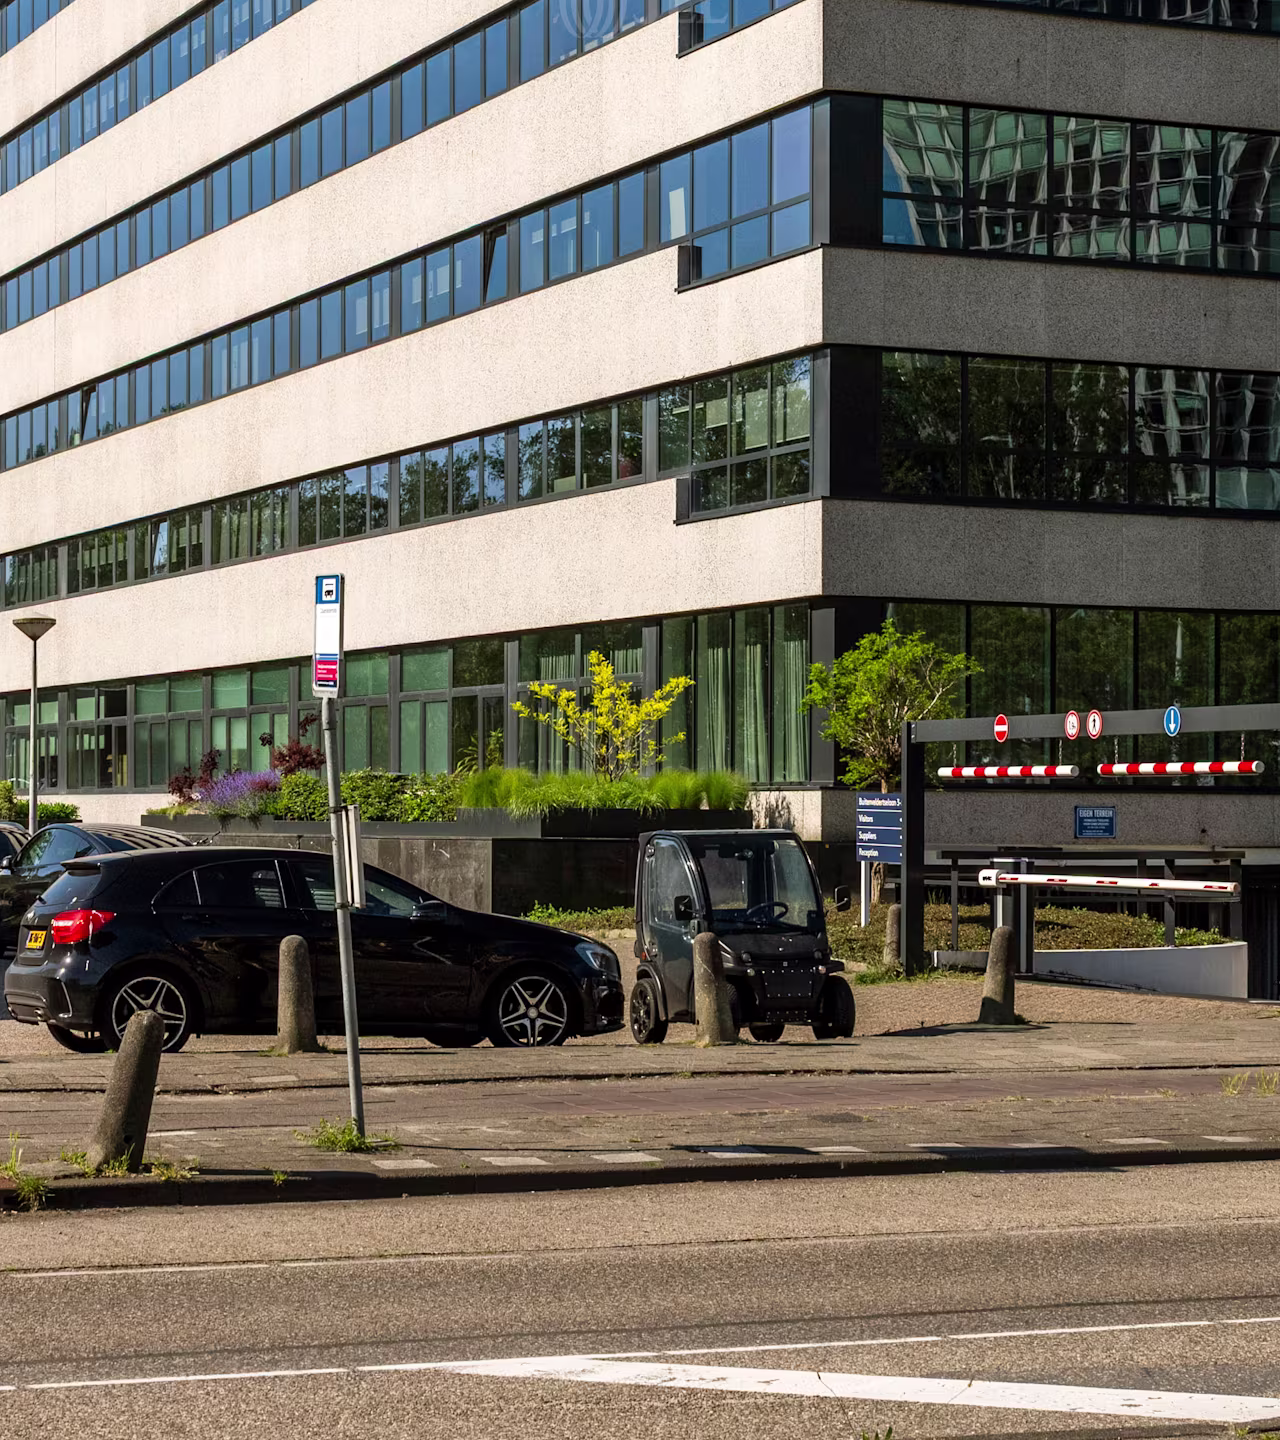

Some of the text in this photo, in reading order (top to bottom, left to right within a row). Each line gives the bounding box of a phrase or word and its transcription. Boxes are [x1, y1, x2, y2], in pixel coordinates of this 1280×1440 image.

[858, 814, 874, 823] Visitors
[858, 831, 877, 841] Suppliers
[858, 848, 879, 858] Reception
